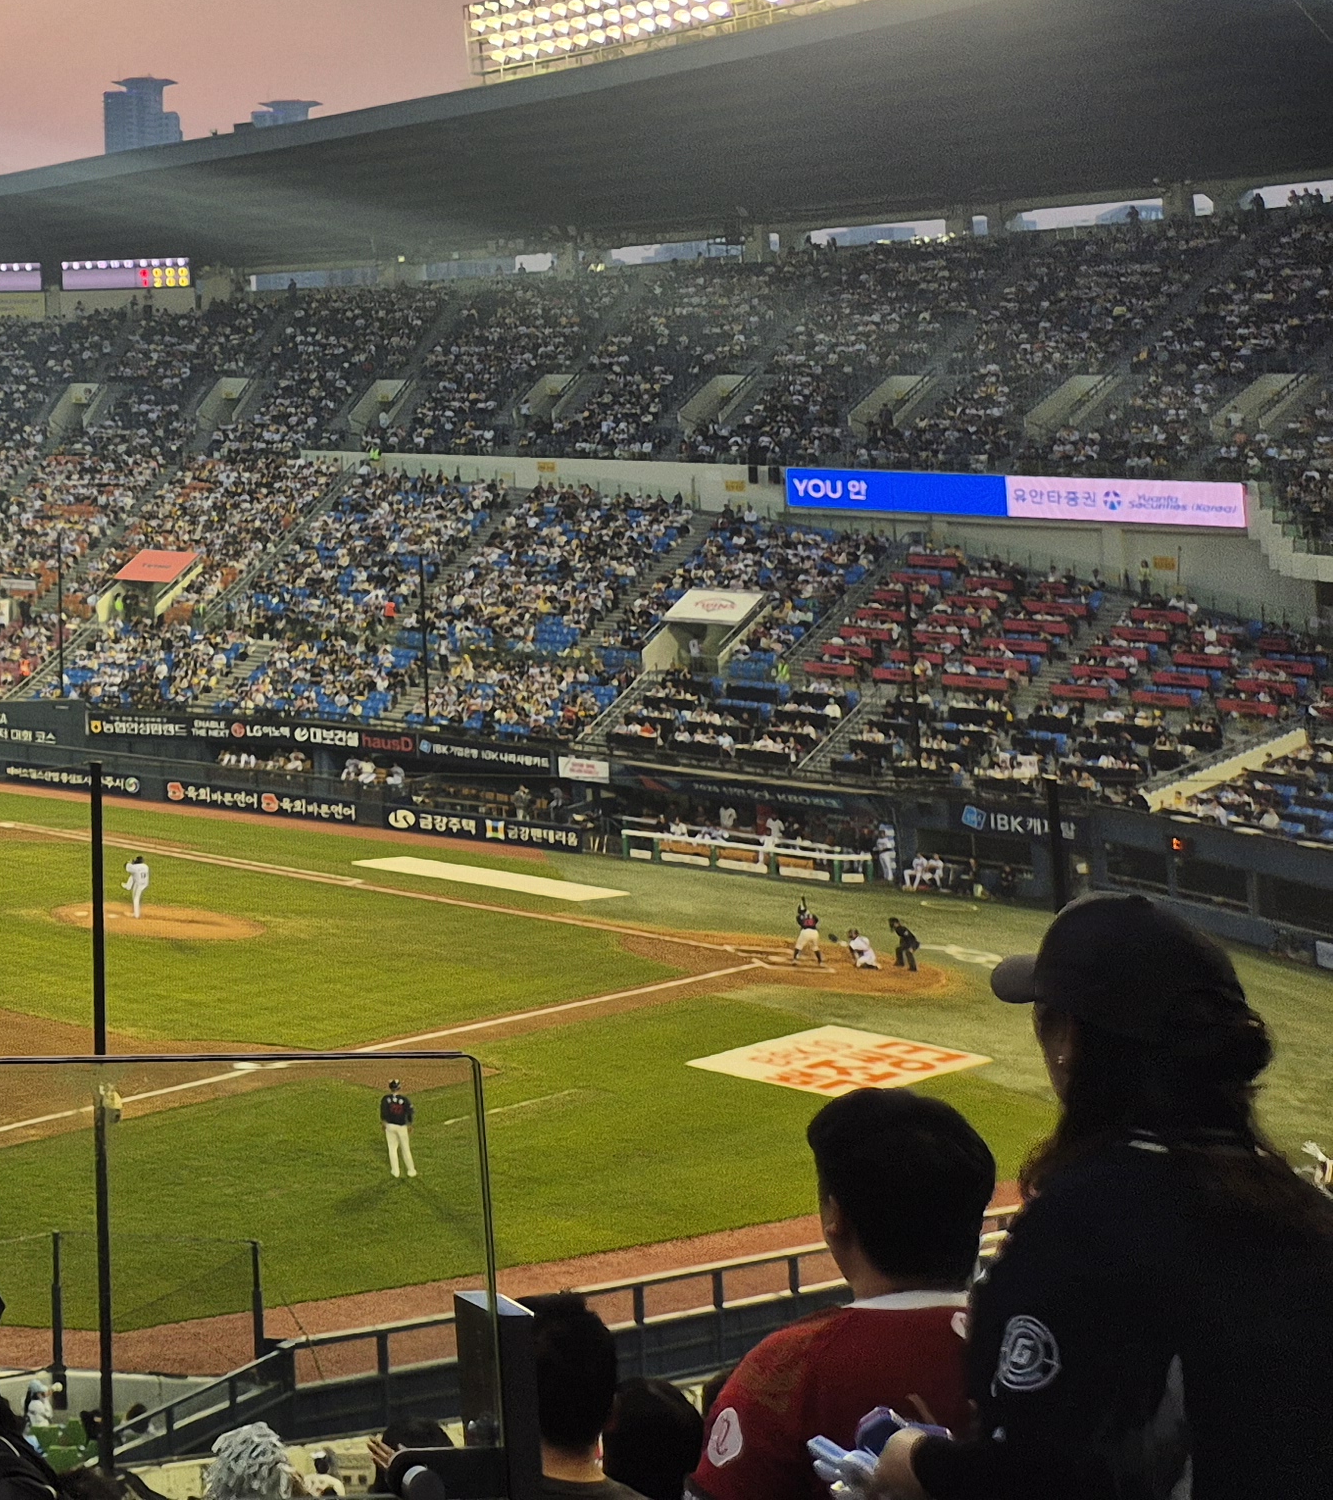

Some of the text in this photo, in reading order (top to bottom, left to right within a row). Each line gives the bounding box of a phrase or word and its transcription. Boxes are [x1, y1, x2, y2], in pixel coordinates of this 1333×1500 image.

[792, 477, 869, 501] YOU 안
[1012, 487, 1097, 509] 유안타증권
[35, 730, 57, 745] 코스
[362, 733, 414, 752] hausD
[418, 812, 477, 837] 금강주택
